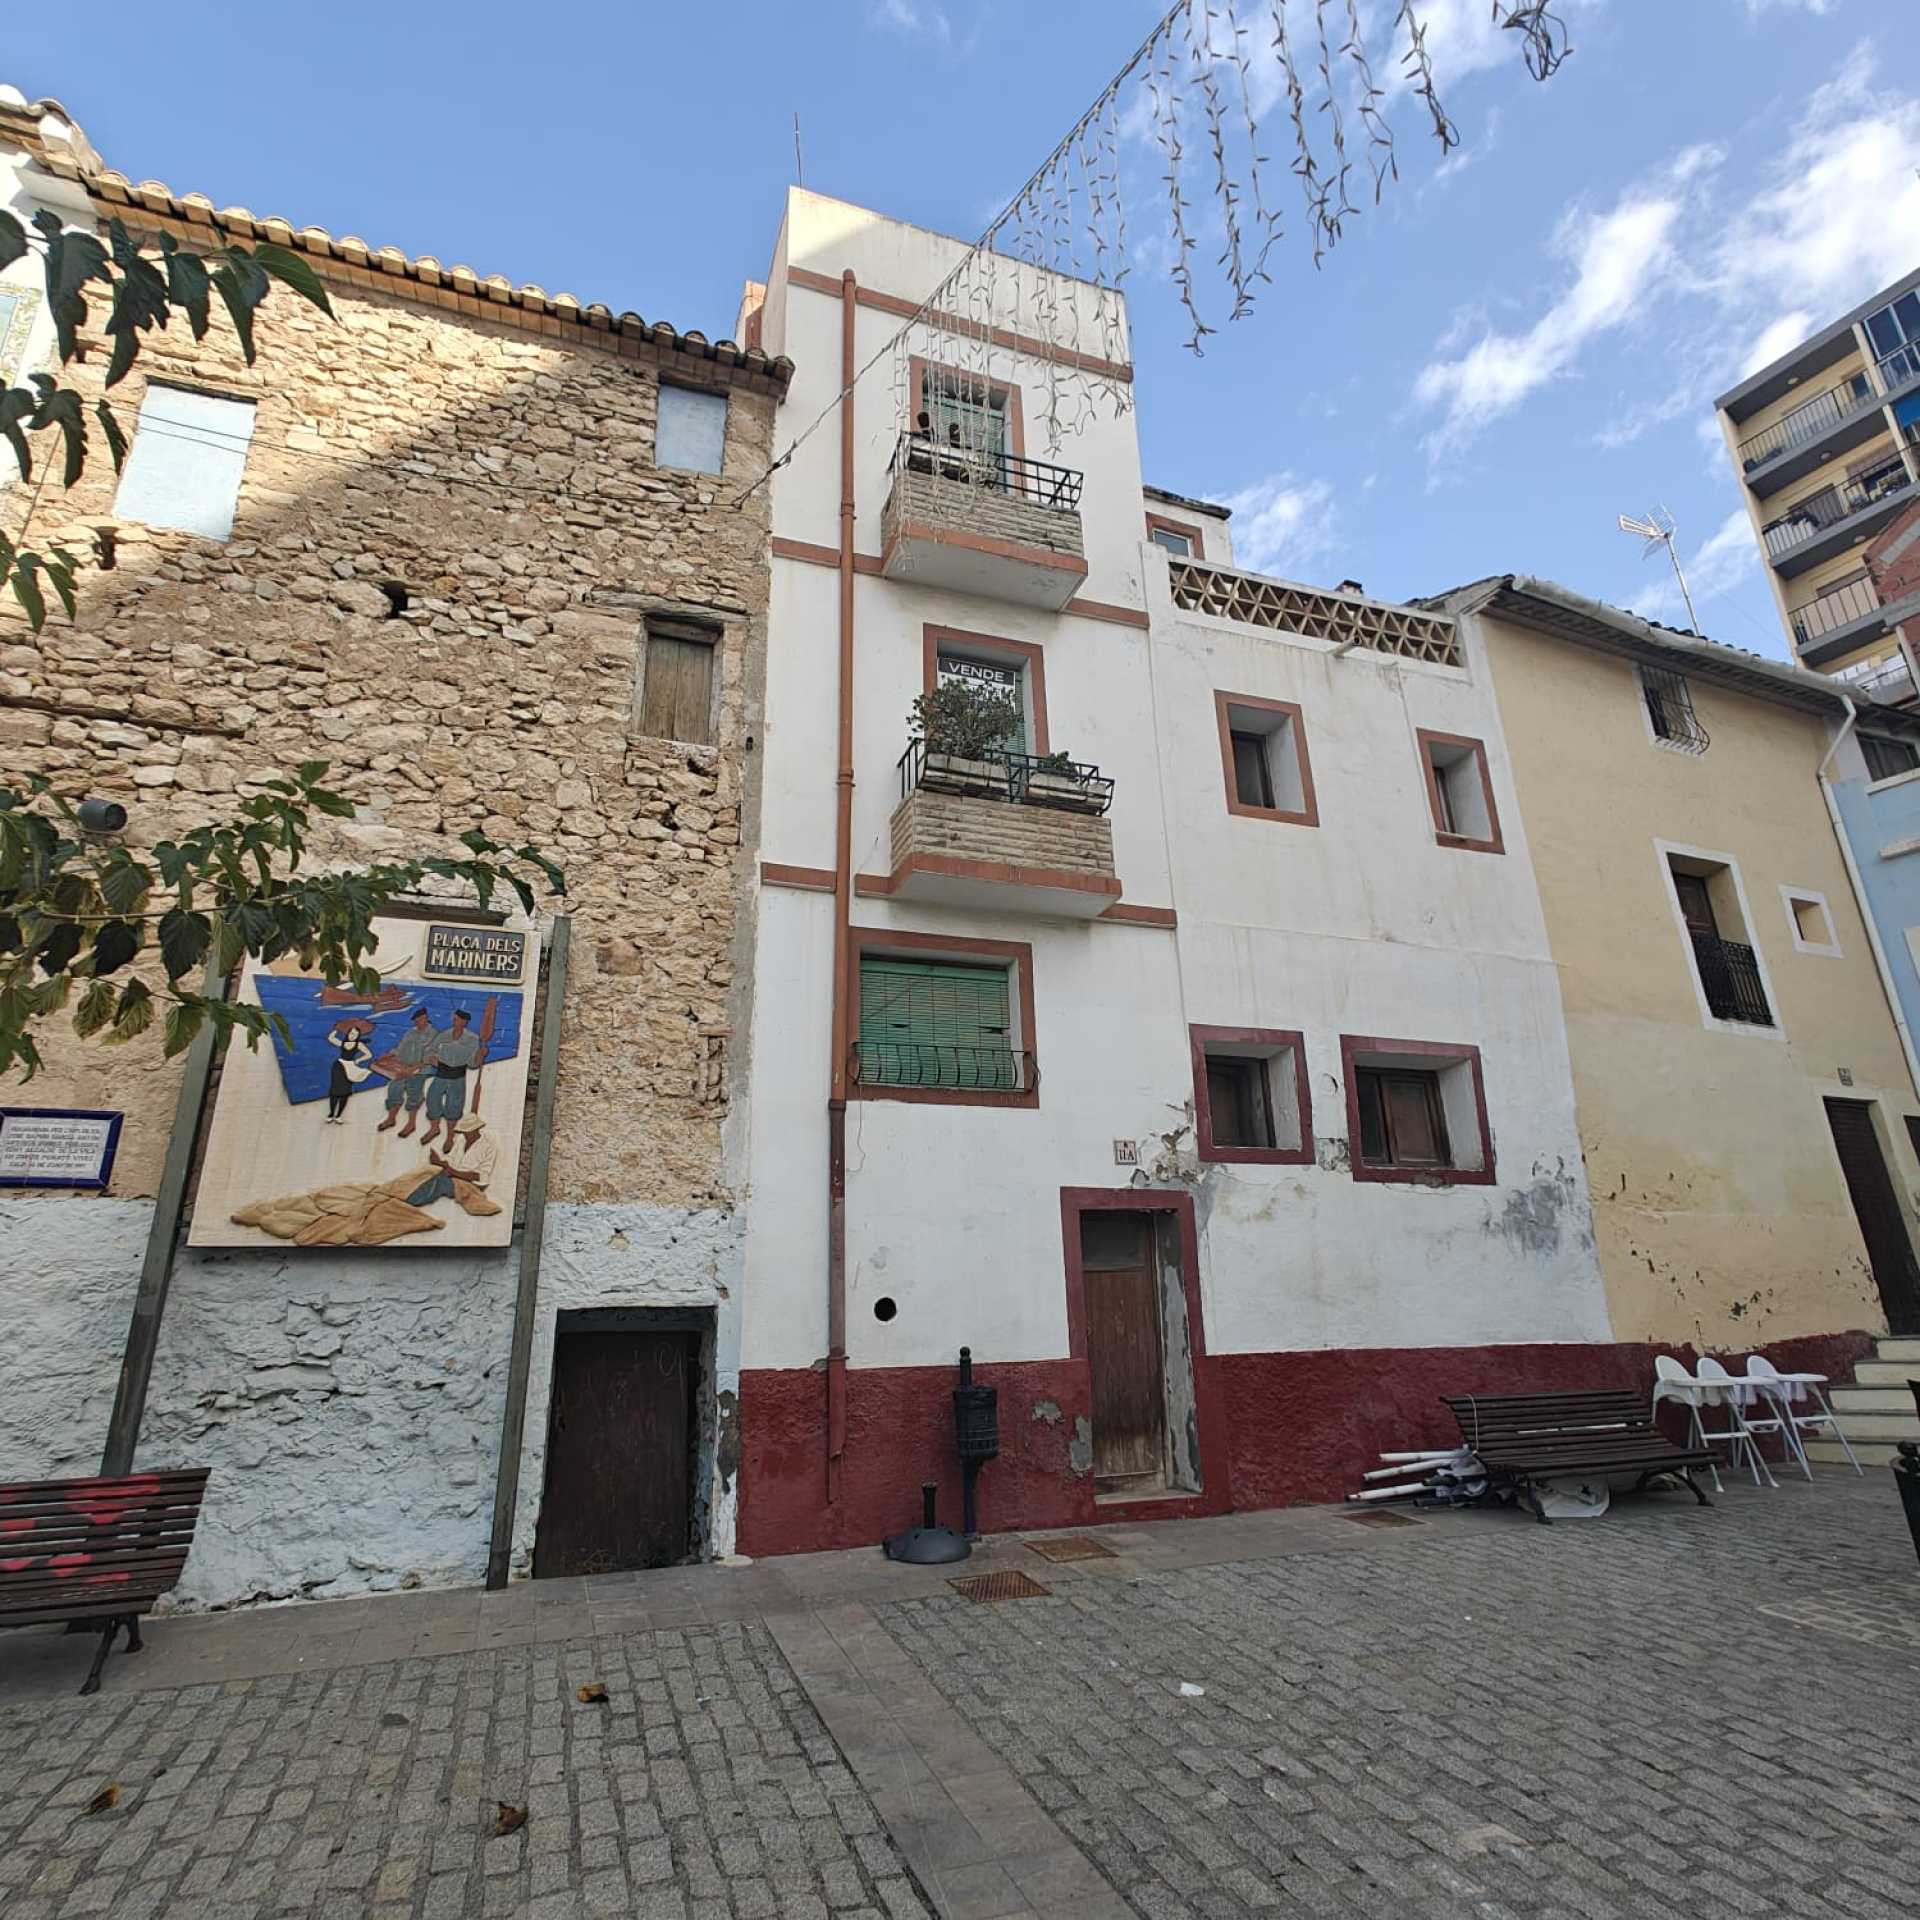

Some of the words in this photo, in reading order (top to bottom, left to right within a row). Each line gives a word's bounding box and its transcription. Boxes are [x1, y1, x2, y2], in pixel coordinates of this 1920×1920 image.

[949, 661, 1005, 682] VENDE
[486, 937, 521, 953] DELS
[430, 949, 519, 971] MARINERS
